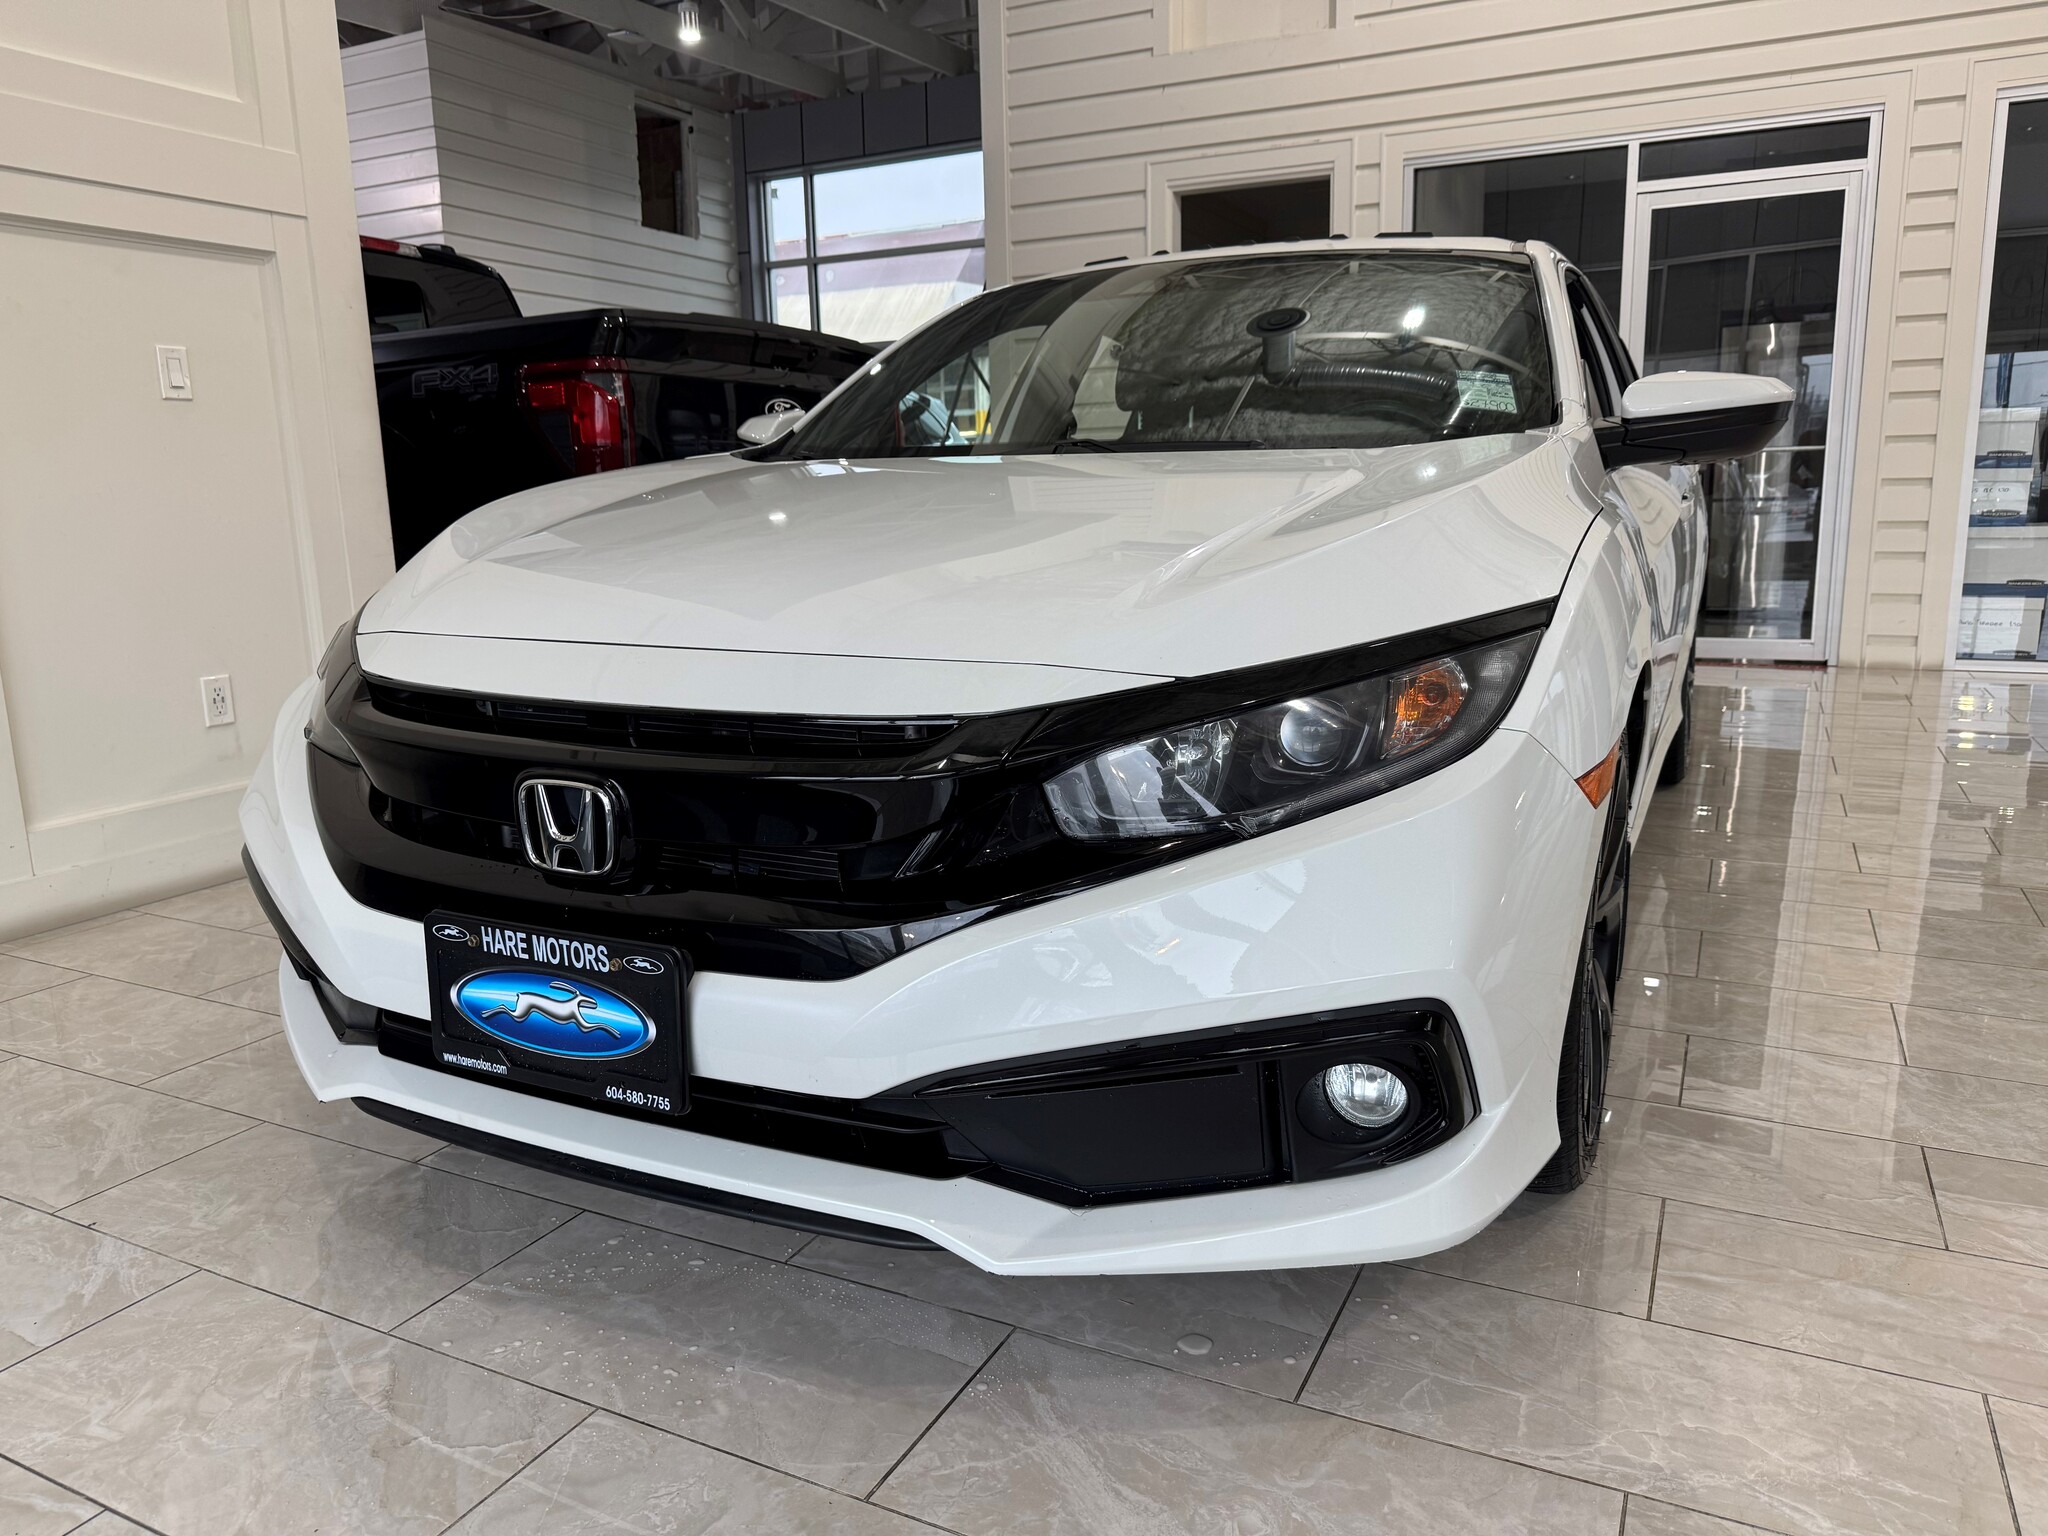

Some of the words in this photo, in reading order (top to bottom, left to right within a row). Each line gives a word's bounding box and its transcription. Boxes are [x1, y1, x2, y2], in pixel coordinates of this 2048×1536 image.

[412, 363, 498, 397] FX4
[480, 925, 530, 960] HARE
[531, 934, 610, 973] MOTORS
[442, 1052, 508, 1075] www.haremotors.com
[605, 1085, 671, 1111] 604-580-7755
